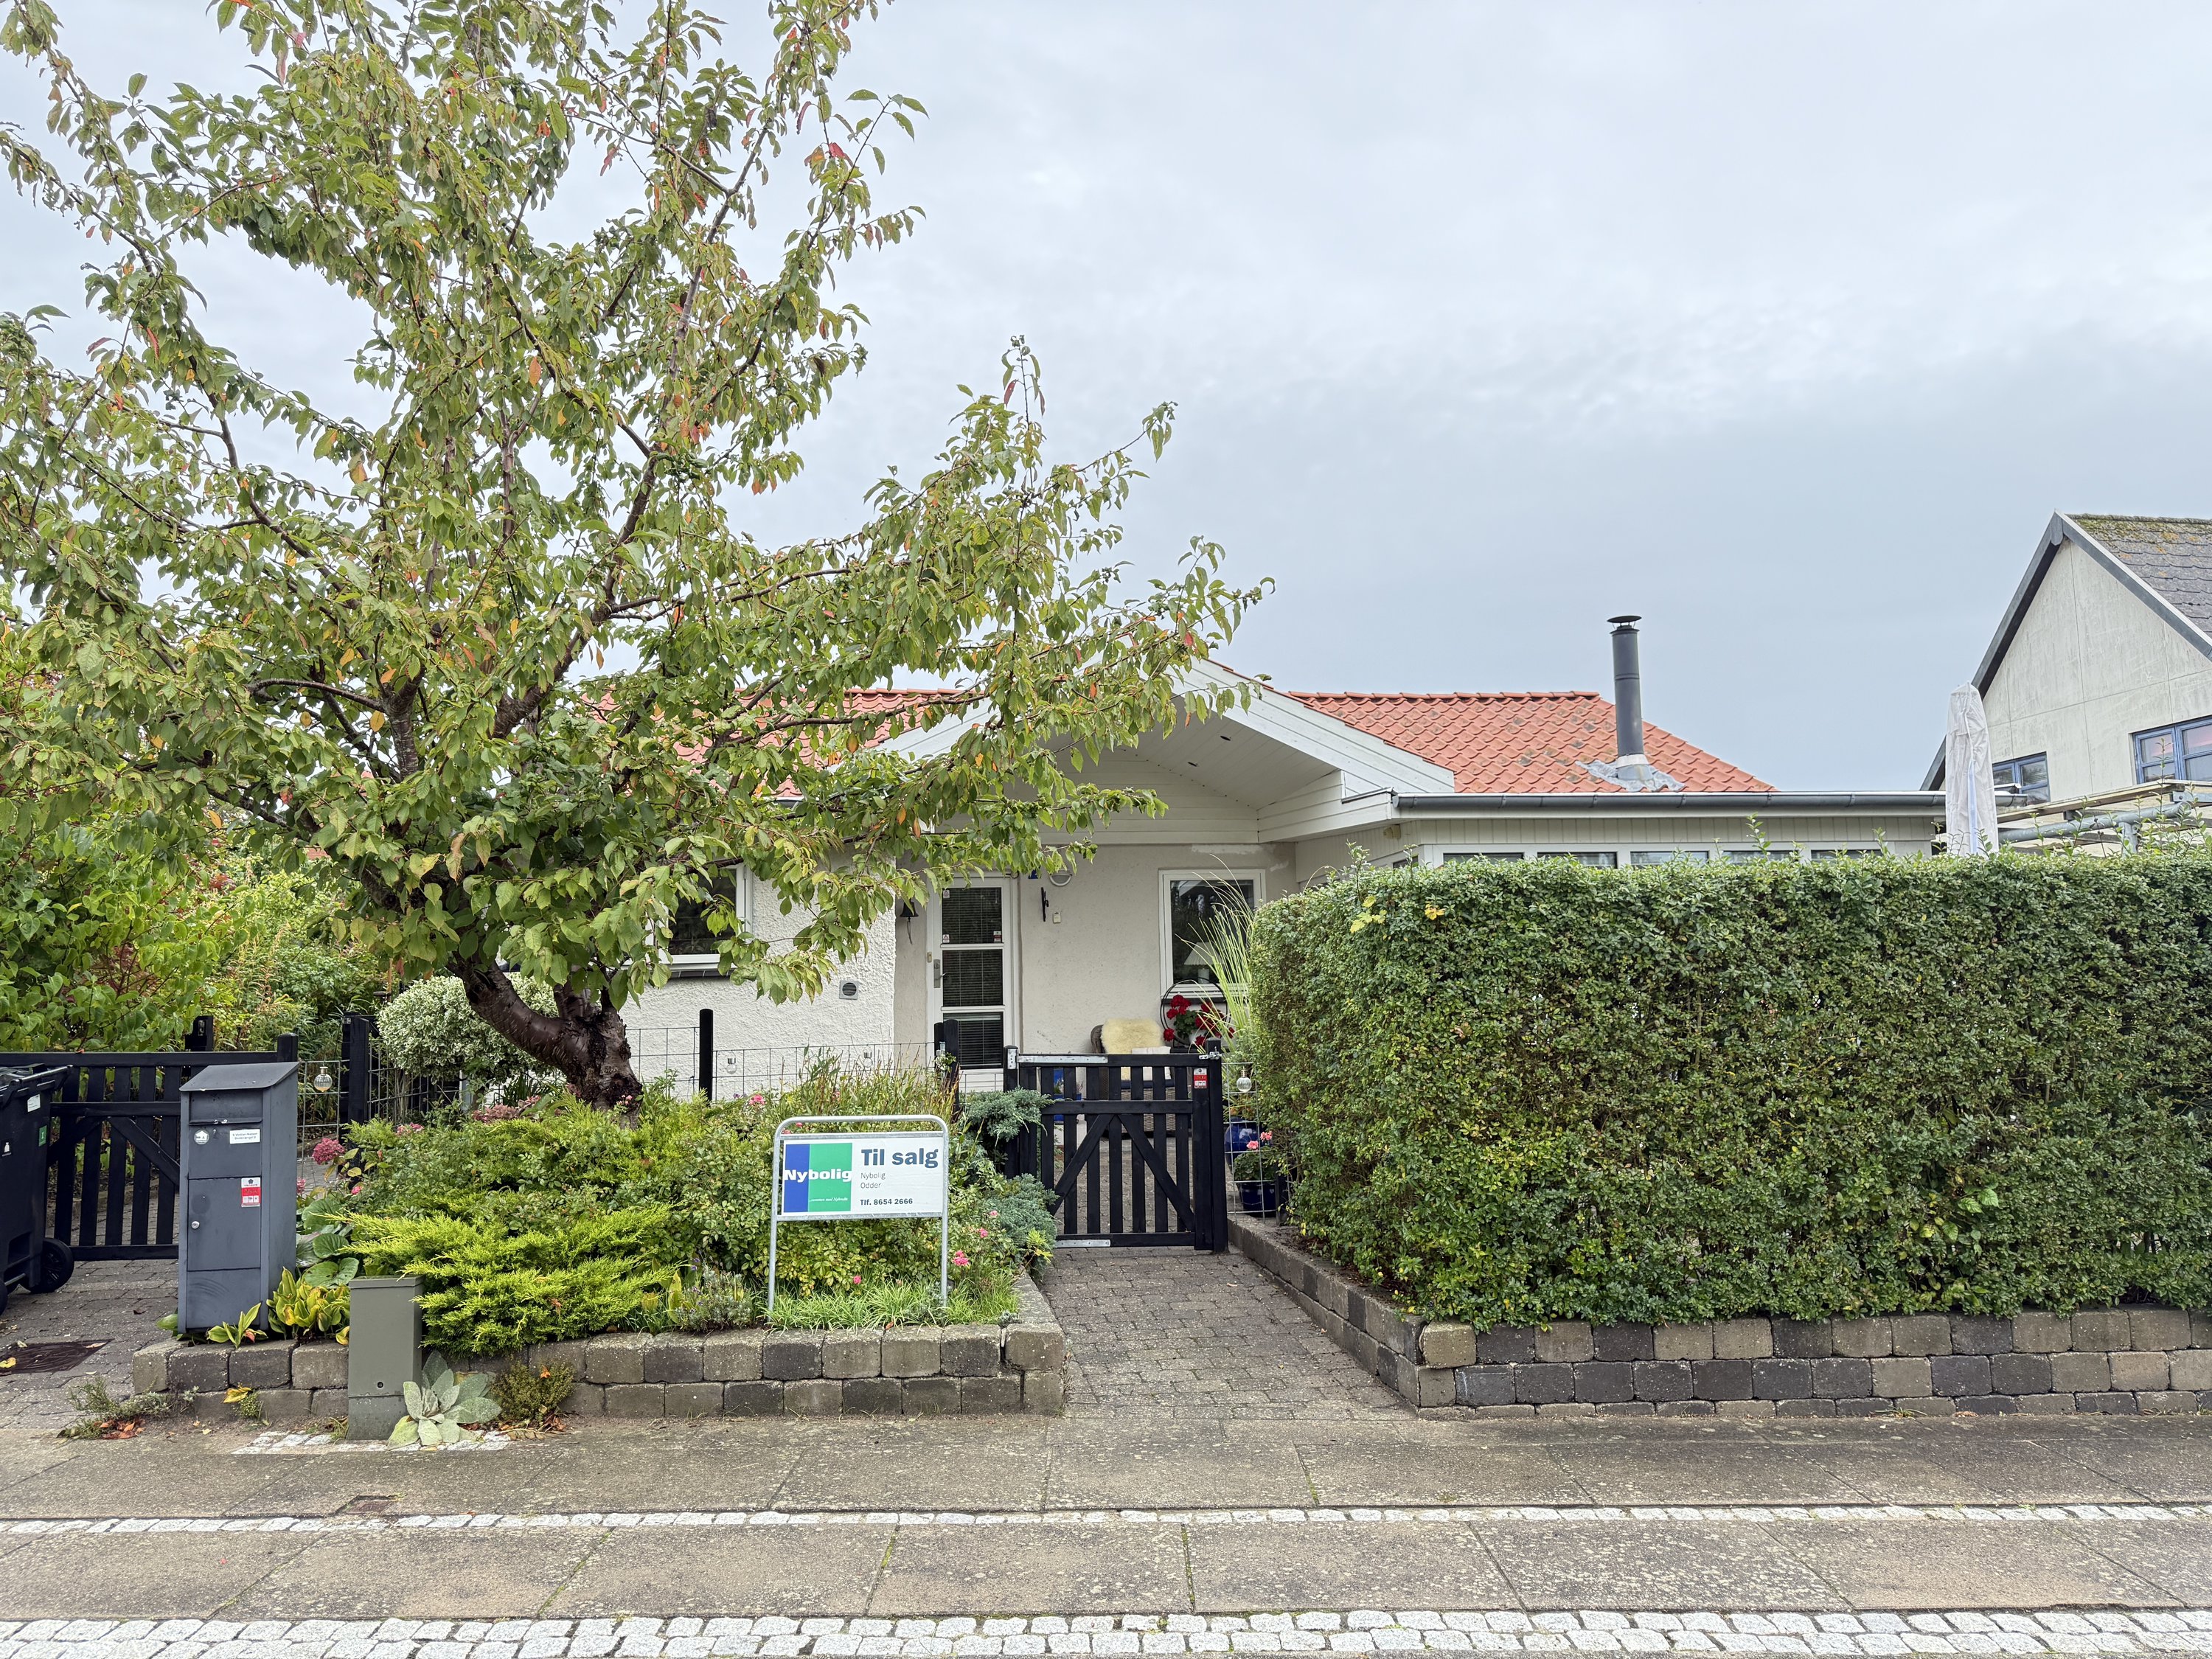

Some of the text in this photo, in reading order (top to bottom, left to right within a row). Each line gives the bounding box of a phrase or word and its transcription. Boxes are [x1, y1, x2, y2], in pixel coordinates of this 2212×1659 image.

[861, 1148, 939, 1169] Til salg
[784, 1169, 853, 1183] Nybolig
